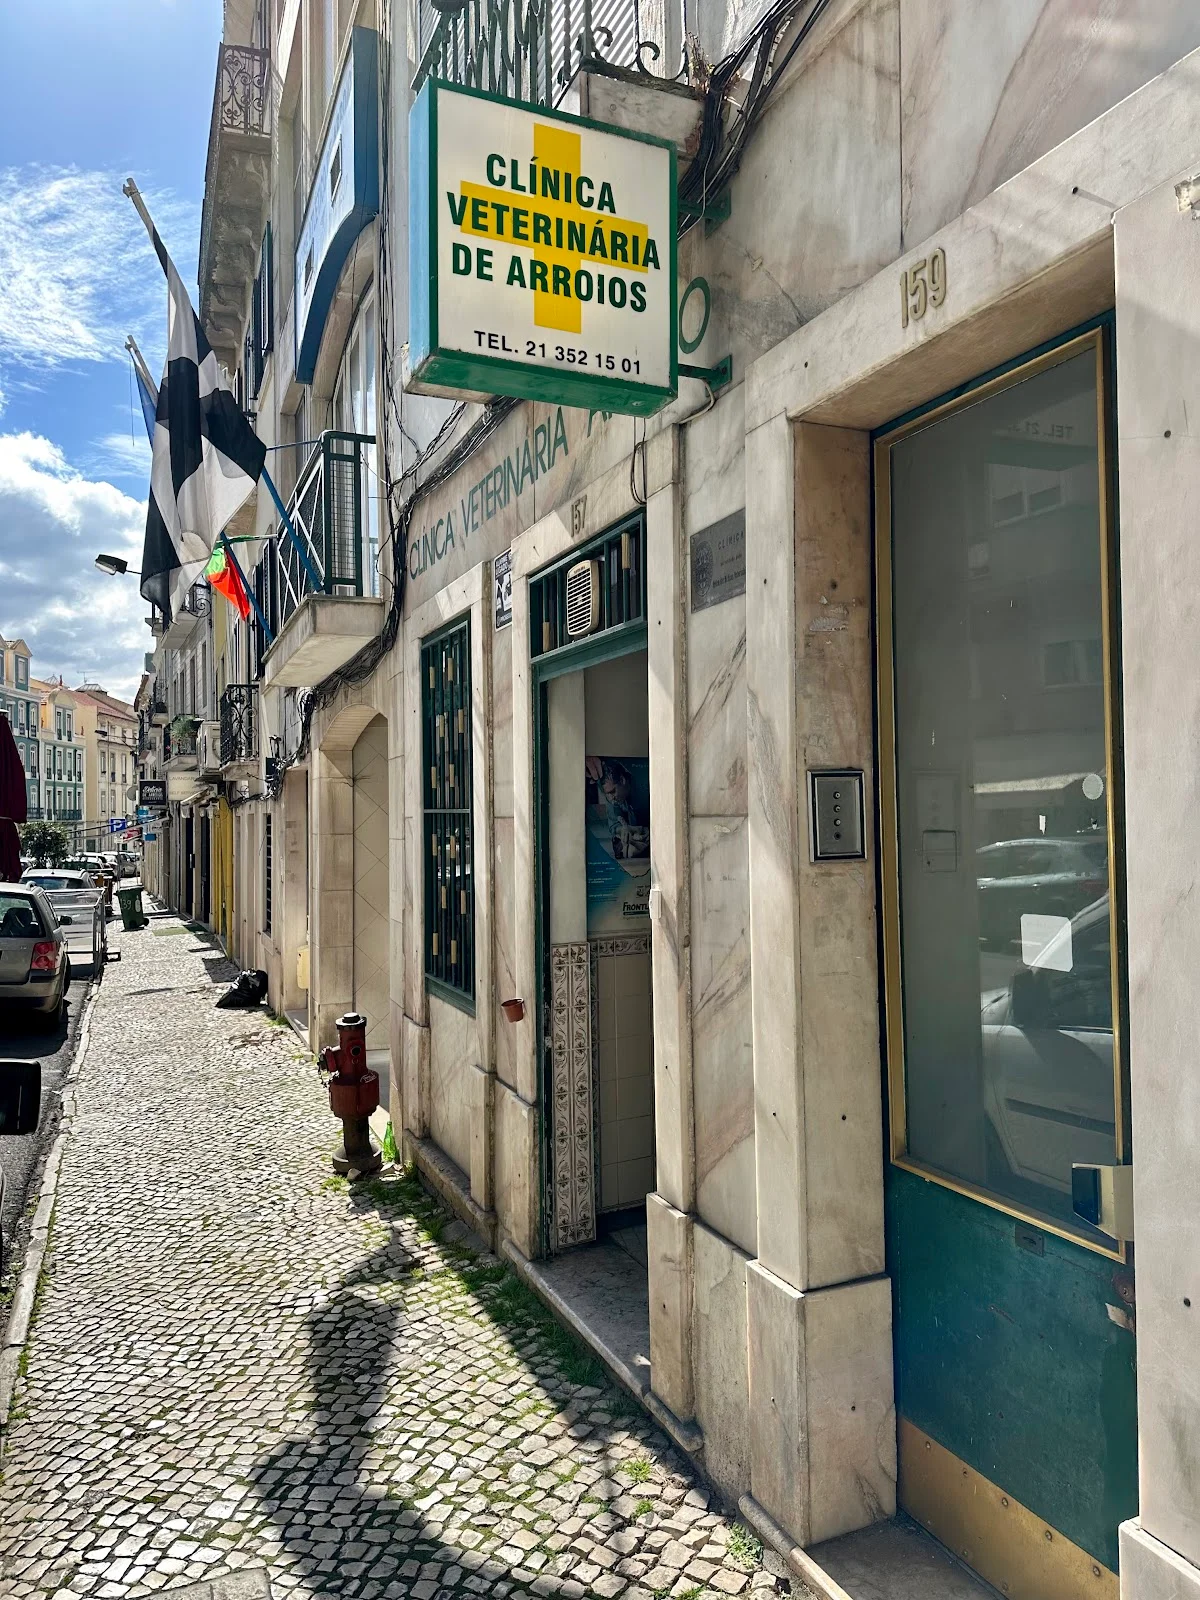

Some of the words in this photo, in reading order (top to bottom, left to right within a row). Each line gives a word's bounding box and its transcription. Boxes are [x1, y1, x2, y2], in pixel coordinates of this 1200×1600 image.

[486, 153, 616, 214] CLÍNICA
[447, 191, 661, 270] VETERINÁRIA
[452, 242, 493, 281] DE
[506, 255, 647, 313] ARROIOS
[900, 247, 947, 328] 159
[473, 330, 519, 354] TEL.
[526, 340, 546, 358] 21
[555, 345, 588, 366] 352
[595, 353, 615, 370] 15
[621, 358, 641, 375] 01
[409, 511, 456, 580] CLÍNICA
[461, 406, 569, 538] VETERINÁRIA
[570, 494, 588, 538] 157
